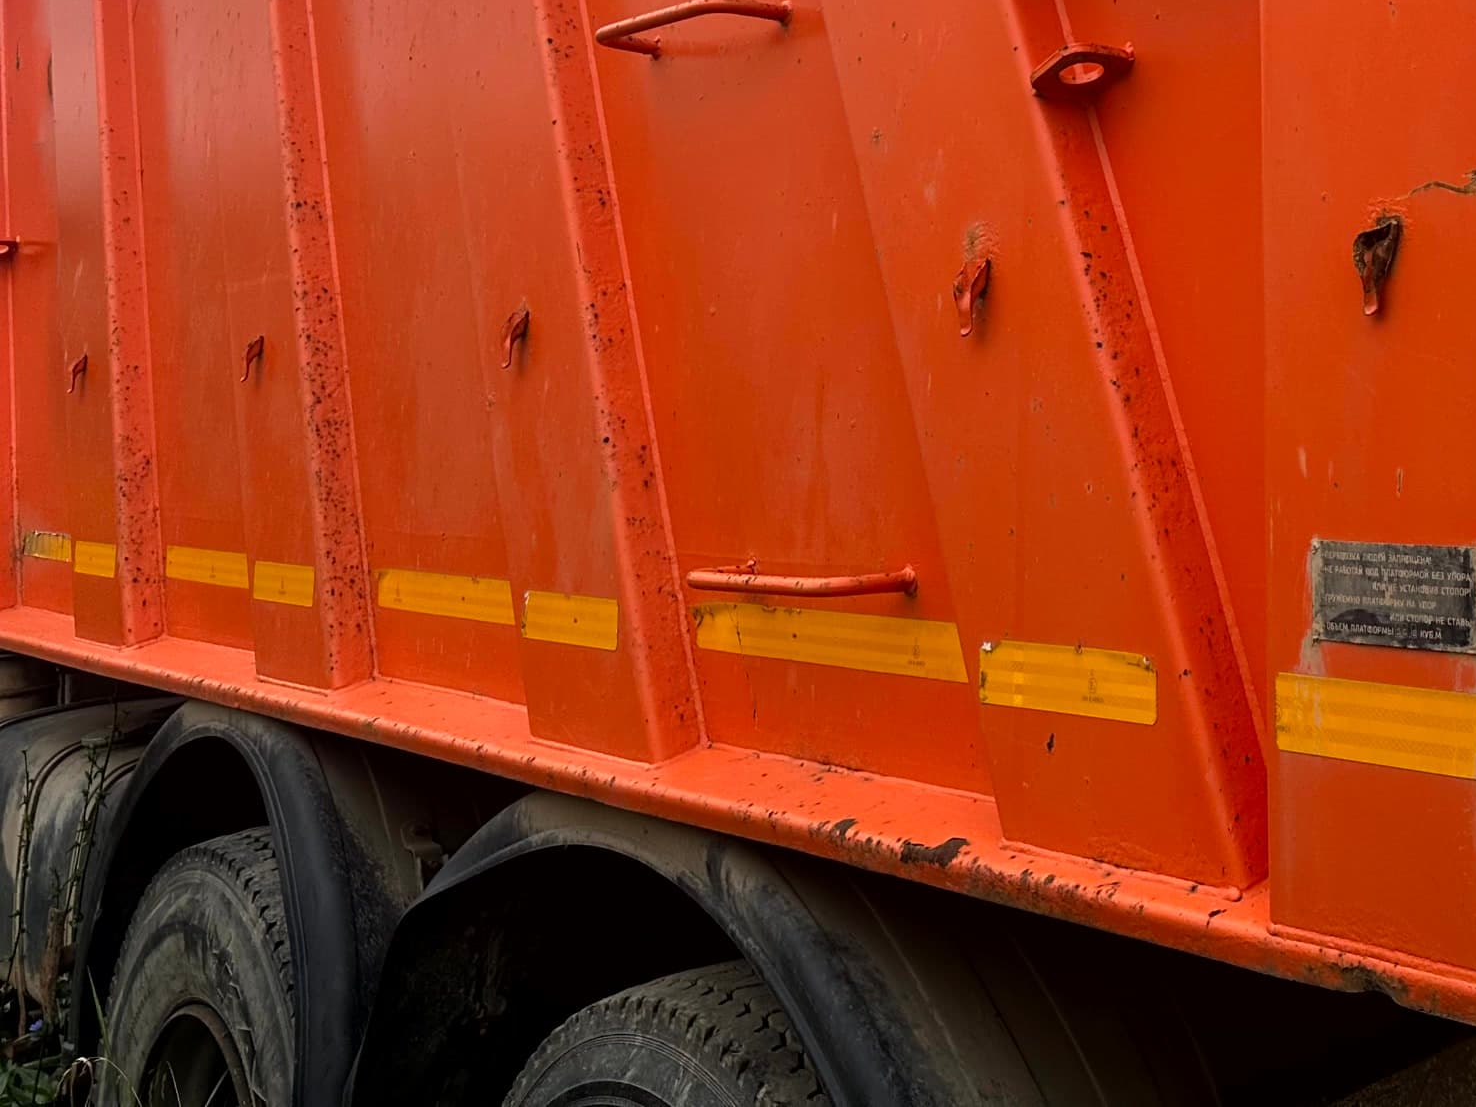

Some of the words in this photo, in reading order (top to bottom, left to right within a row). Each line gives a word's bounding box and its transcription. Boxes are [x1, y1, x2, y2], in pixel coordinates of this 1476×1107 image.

[1431, 571, 1444, 580] БЕЗ
[1435, 616, 1445, 625] НЕ
[1351, 624, 1394, 635] ПЛАТФОРМЫ
